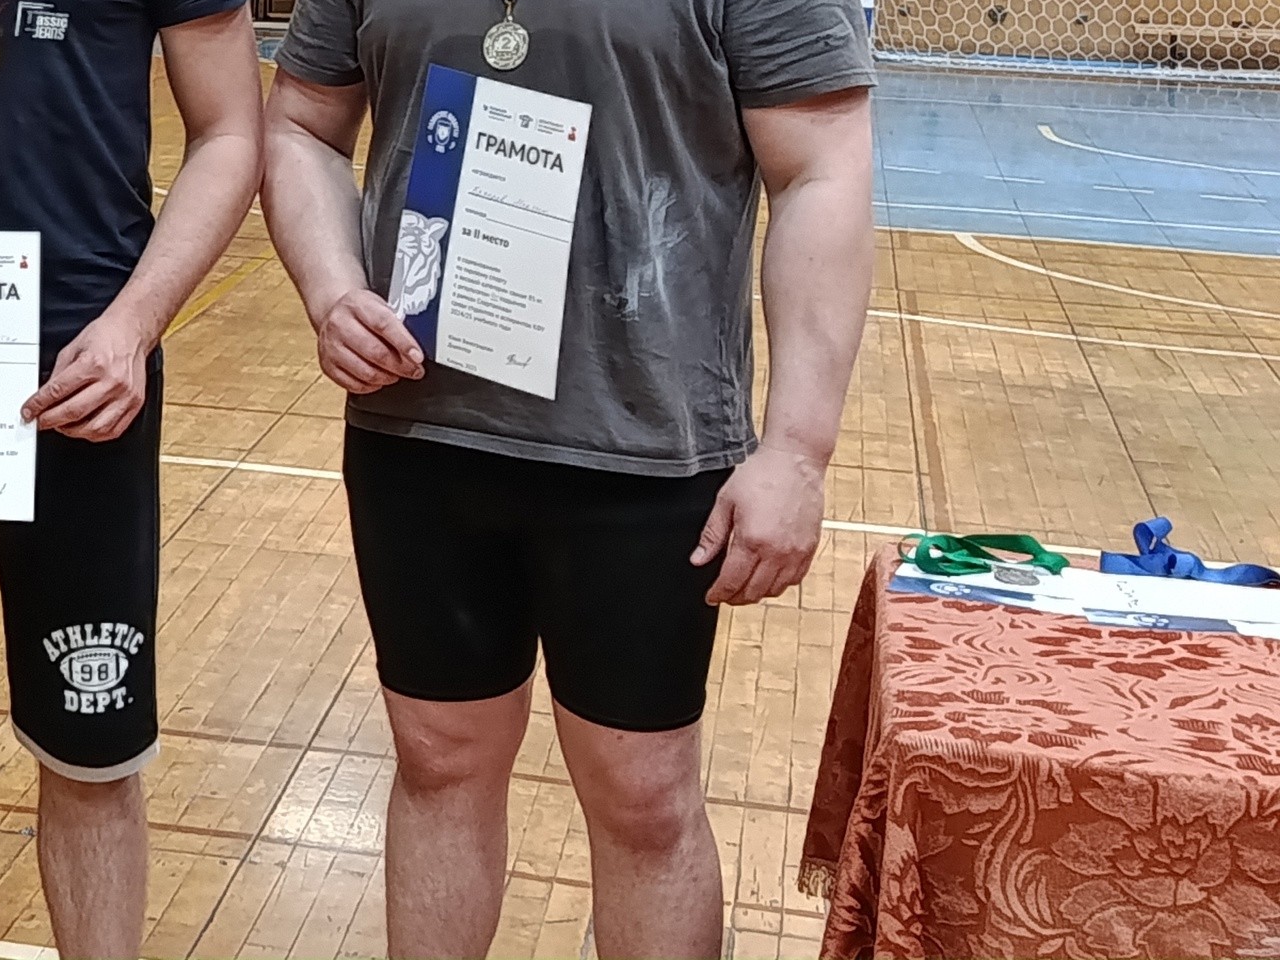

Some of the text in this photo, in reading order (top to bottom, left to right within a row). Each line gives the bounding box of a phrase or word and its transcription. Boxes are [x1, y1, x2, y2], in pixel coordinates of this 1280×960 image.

[476, 131, 564, 173] ГРАМОТА
[462, 227, 471, 236] за
[482, 233, 510, 248] место
[42, 622, 145, 662] ATHLETIC
[81, 663, 108, 682] 98
[63, 686, 134, 714] DEPT.
